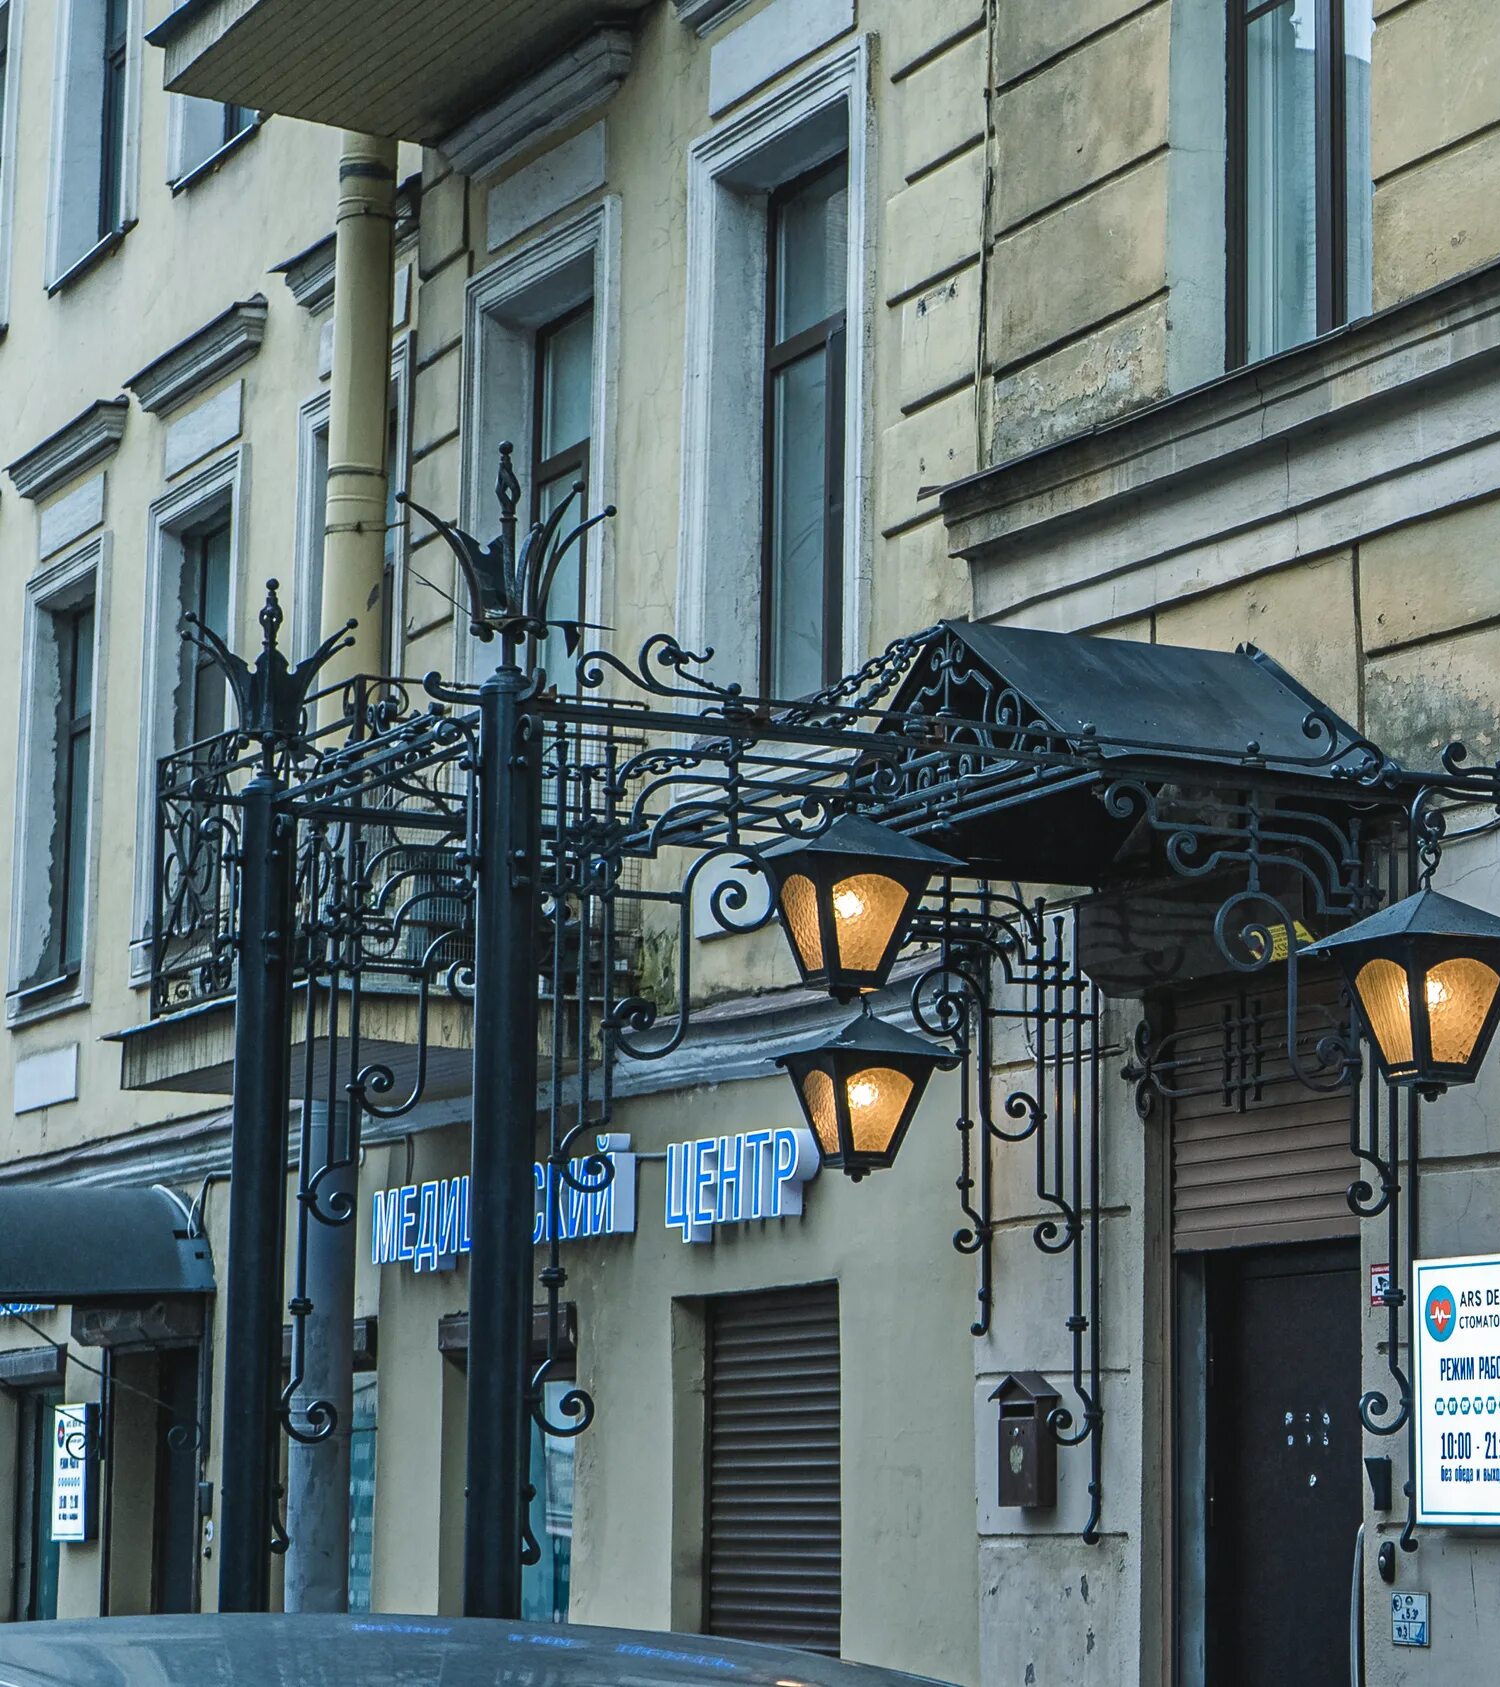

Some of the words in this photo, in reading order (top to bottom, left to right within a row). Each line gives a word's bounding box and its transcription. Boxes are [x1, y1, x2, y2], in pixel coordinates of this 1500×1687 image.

[664, 1127, 800, 1244] ЦЕНТР
[1460, 1290, 1482, 1307] ARS
[1440, 1357, 1474, 1381] РЕЖИМ
[1440, 1432, 1471, 1460] 10:00
[1441, 1465, 1452, 1481] без
[1455, 1465, 1473, 1483] обеда
